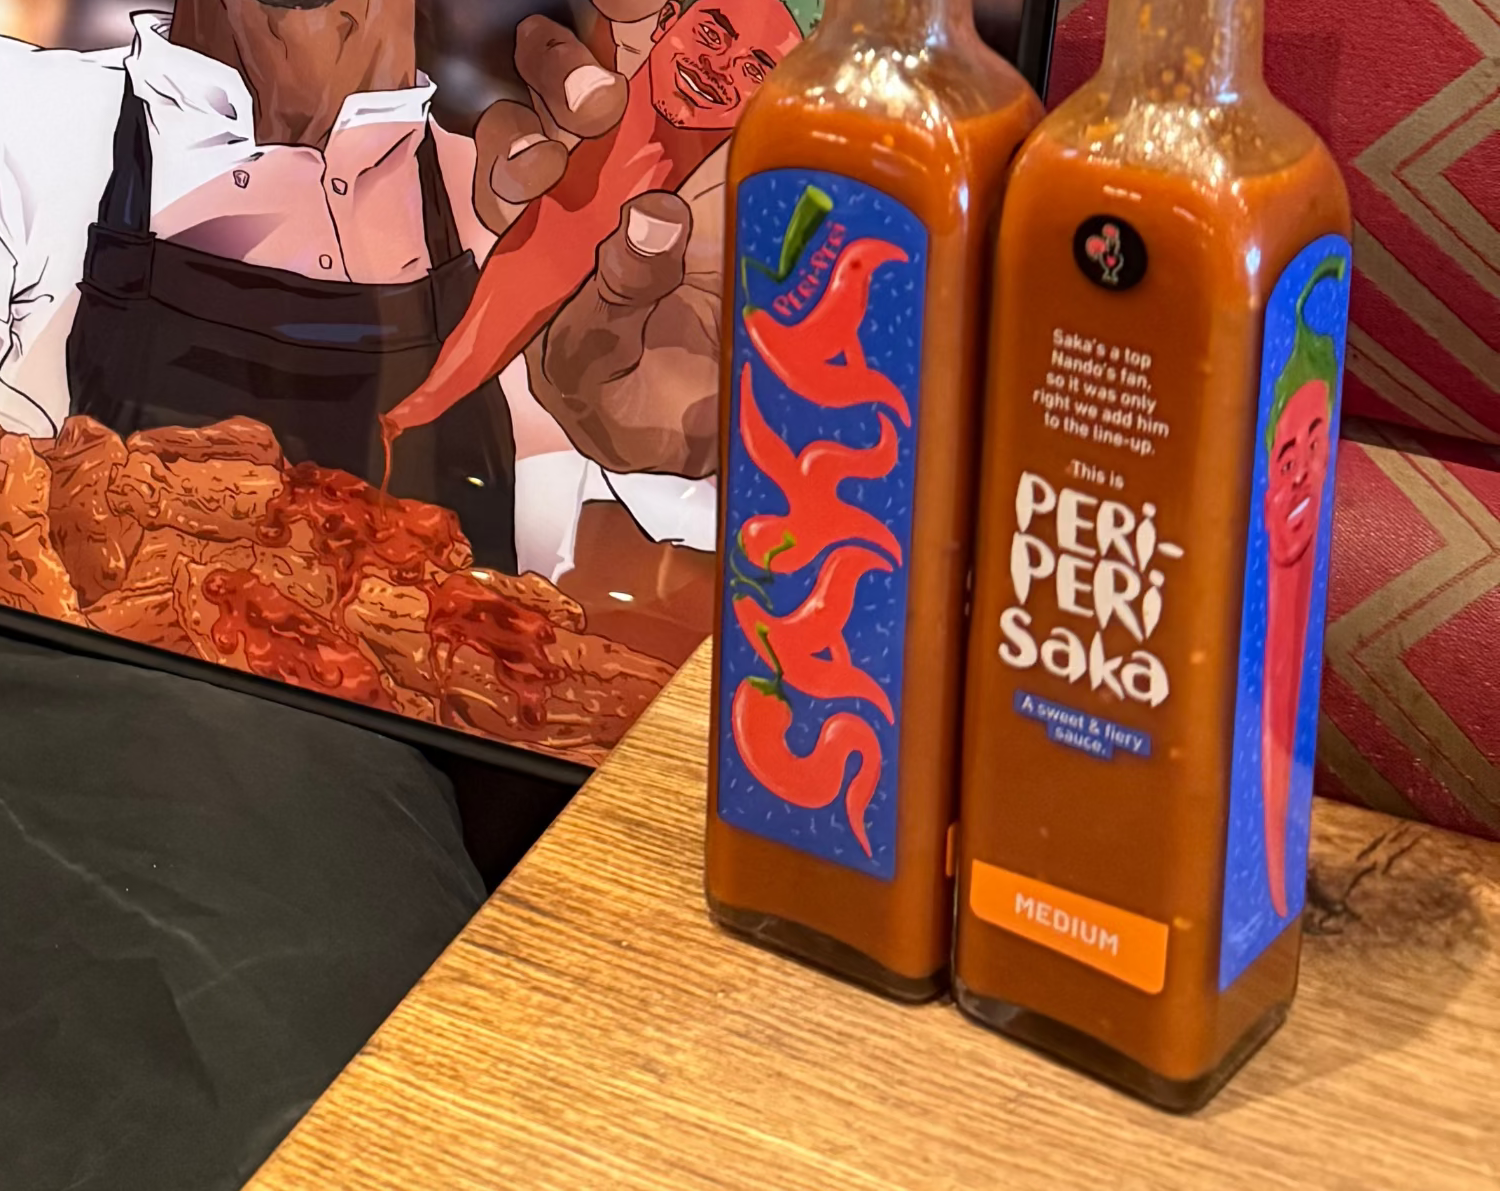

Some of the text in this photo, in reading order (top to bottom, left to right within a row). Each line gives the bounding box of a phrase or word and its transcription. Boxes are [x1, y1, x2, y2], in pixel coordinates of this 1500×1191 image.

[1051, 348, 1152, 392] Nando's fan,
[1053, 328, 1151, 371] Saka's a top
[1033, 388, 1169, 439] right we add him
[1046, 372, 1157, 415] so it was only
[1044, 411, 1156, 457] to the line-up.
[1071, 458, 1125, 491] This is
[998, 606, 1170, 708] Saka
[1021, 694, 1143, 752] A sweet & fiery
[1054, 726, 1107, 755] sauce.
[1014, 891, 1119, 957] MEDIUM
